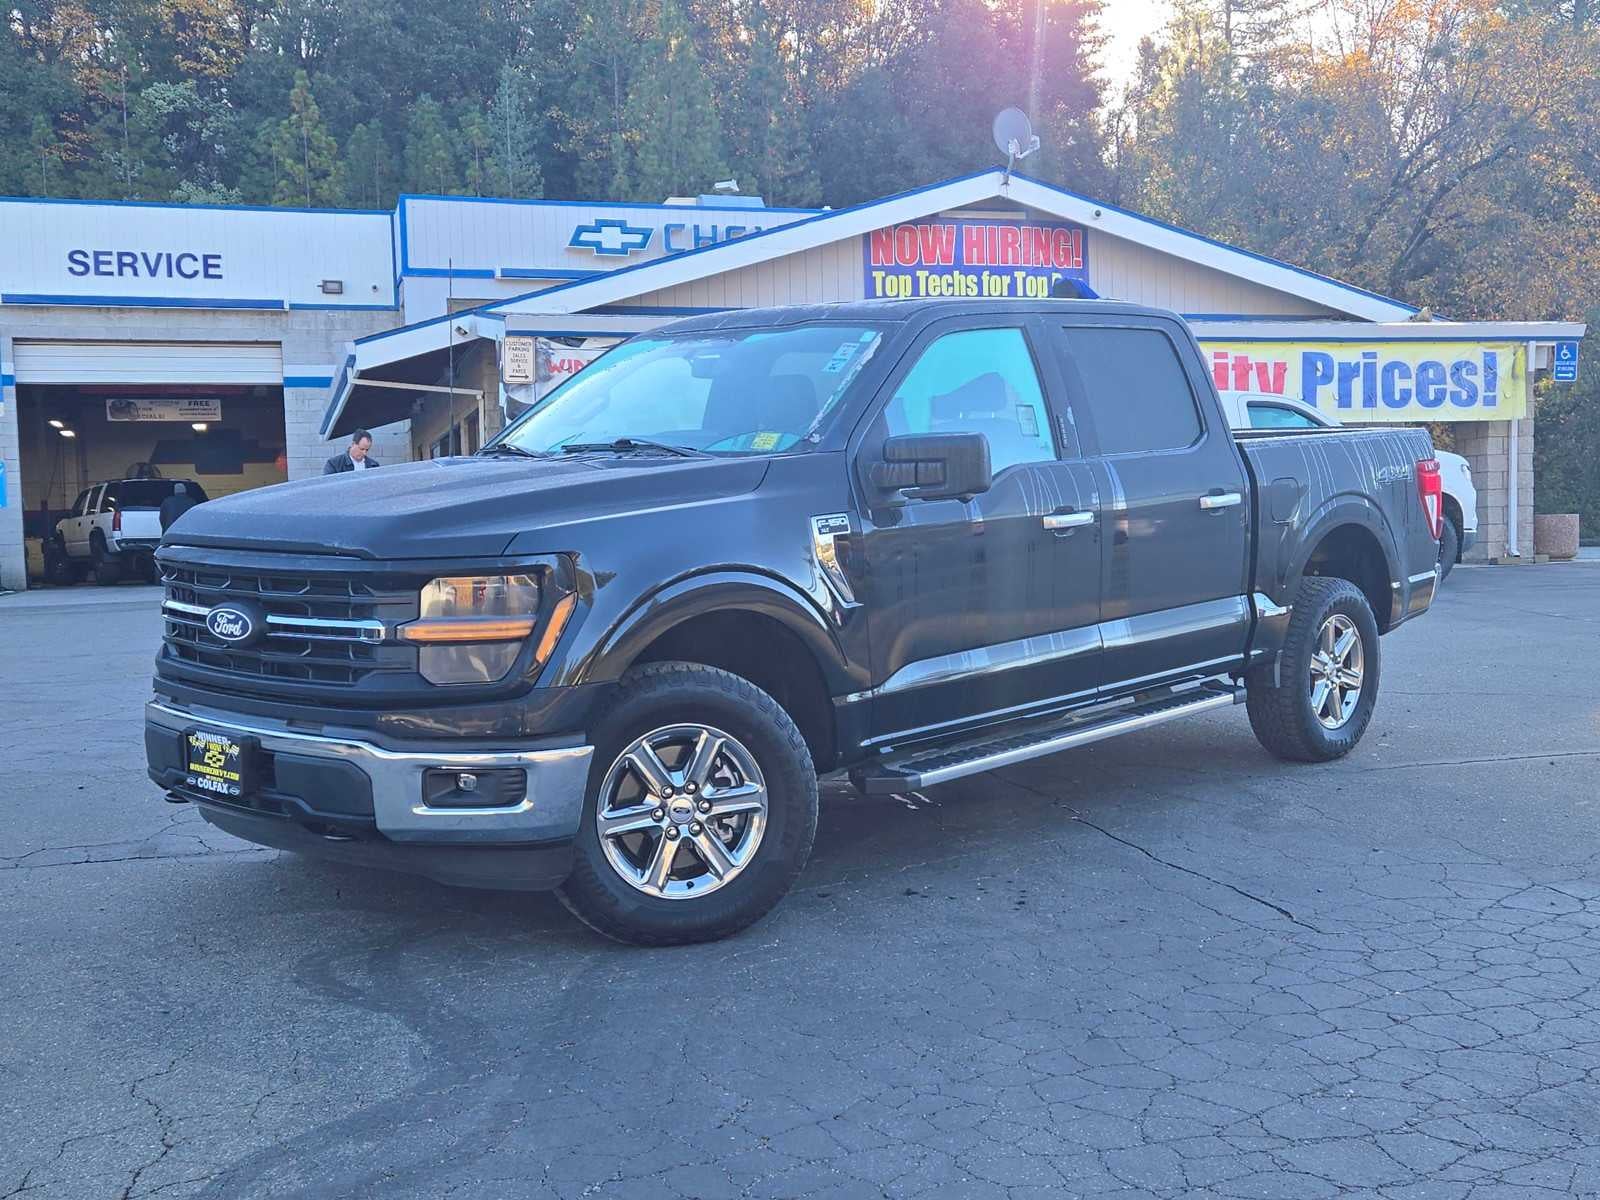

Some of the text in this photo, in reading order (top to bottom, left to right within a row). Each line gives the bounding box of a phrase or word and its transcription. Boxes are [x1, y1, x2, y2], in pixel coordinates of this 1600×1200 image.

[870, 224, 1084, 269] NOW HIRING!
[67, 249, 223, 279] SERVICE
[872, 270, 1049, 298] Top Techs for Top
[1302, 351, 1498, 409] Prices!
[817, 517, 847, 528] F-150
[214, 612, 243, 636] Ford
[197, 777, 228, 794] COLFAX
